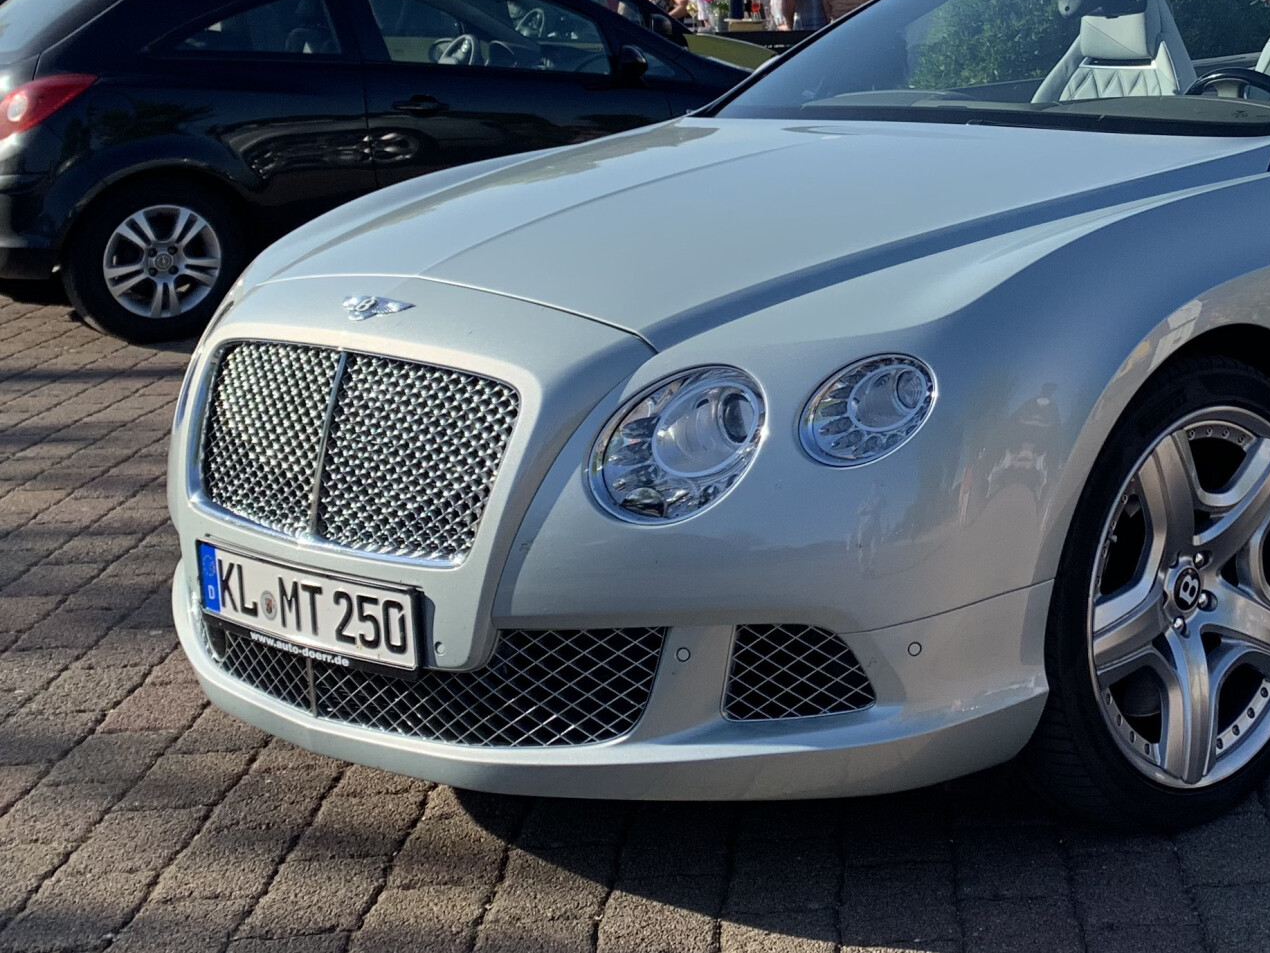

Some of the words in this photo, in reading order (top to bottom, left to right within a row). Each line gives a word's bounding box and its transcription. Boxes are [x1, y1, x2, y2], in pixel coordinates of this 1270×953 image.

[207, 584, 216, 600] D
[218, 559, 258, 617] KL
[278, 577, 323, 636] MT
[333, 591, 407, 654] 250
[1179, 575, 1199, 605] B
[249, 630, 350, 667] www.auto-doerr.de
